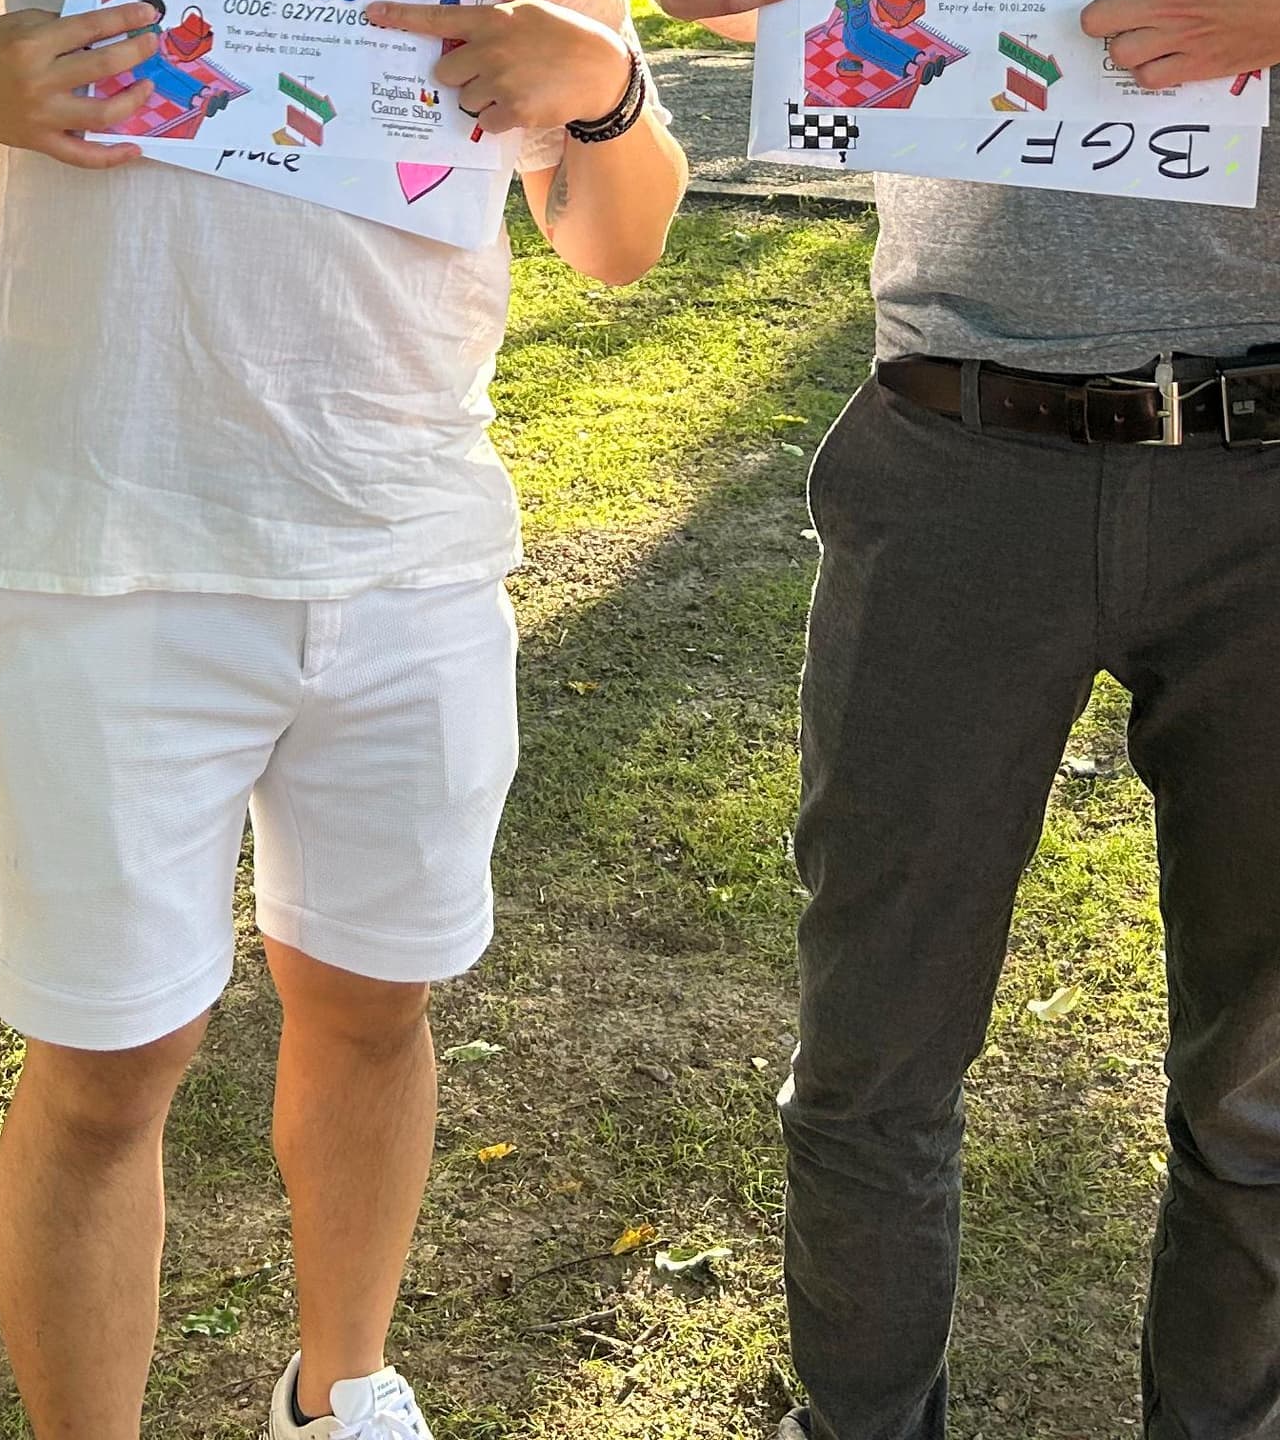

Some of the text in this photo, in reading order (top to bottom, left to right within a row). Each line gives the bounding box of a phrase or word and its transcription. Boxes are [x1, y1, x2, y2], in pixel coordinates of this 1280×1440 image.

[939, 2, 968, 13] Expiry
[999, 3, 1045, 12] 01.01.2026
[224, 40, 253, 53] Expiry
[226, 26, 241, 35] The
[245, 28, 277, 39] voucher
[281, 32, 289, 40] is
[291, 33, 340, 44] redeemable
[355, 38, 377, 48] store
[379, 41, 388, 49] or
[391, 42, 417, 52] online
[371, 82, 415, 100] English
[371, 100, 442, 123] Game Shop
